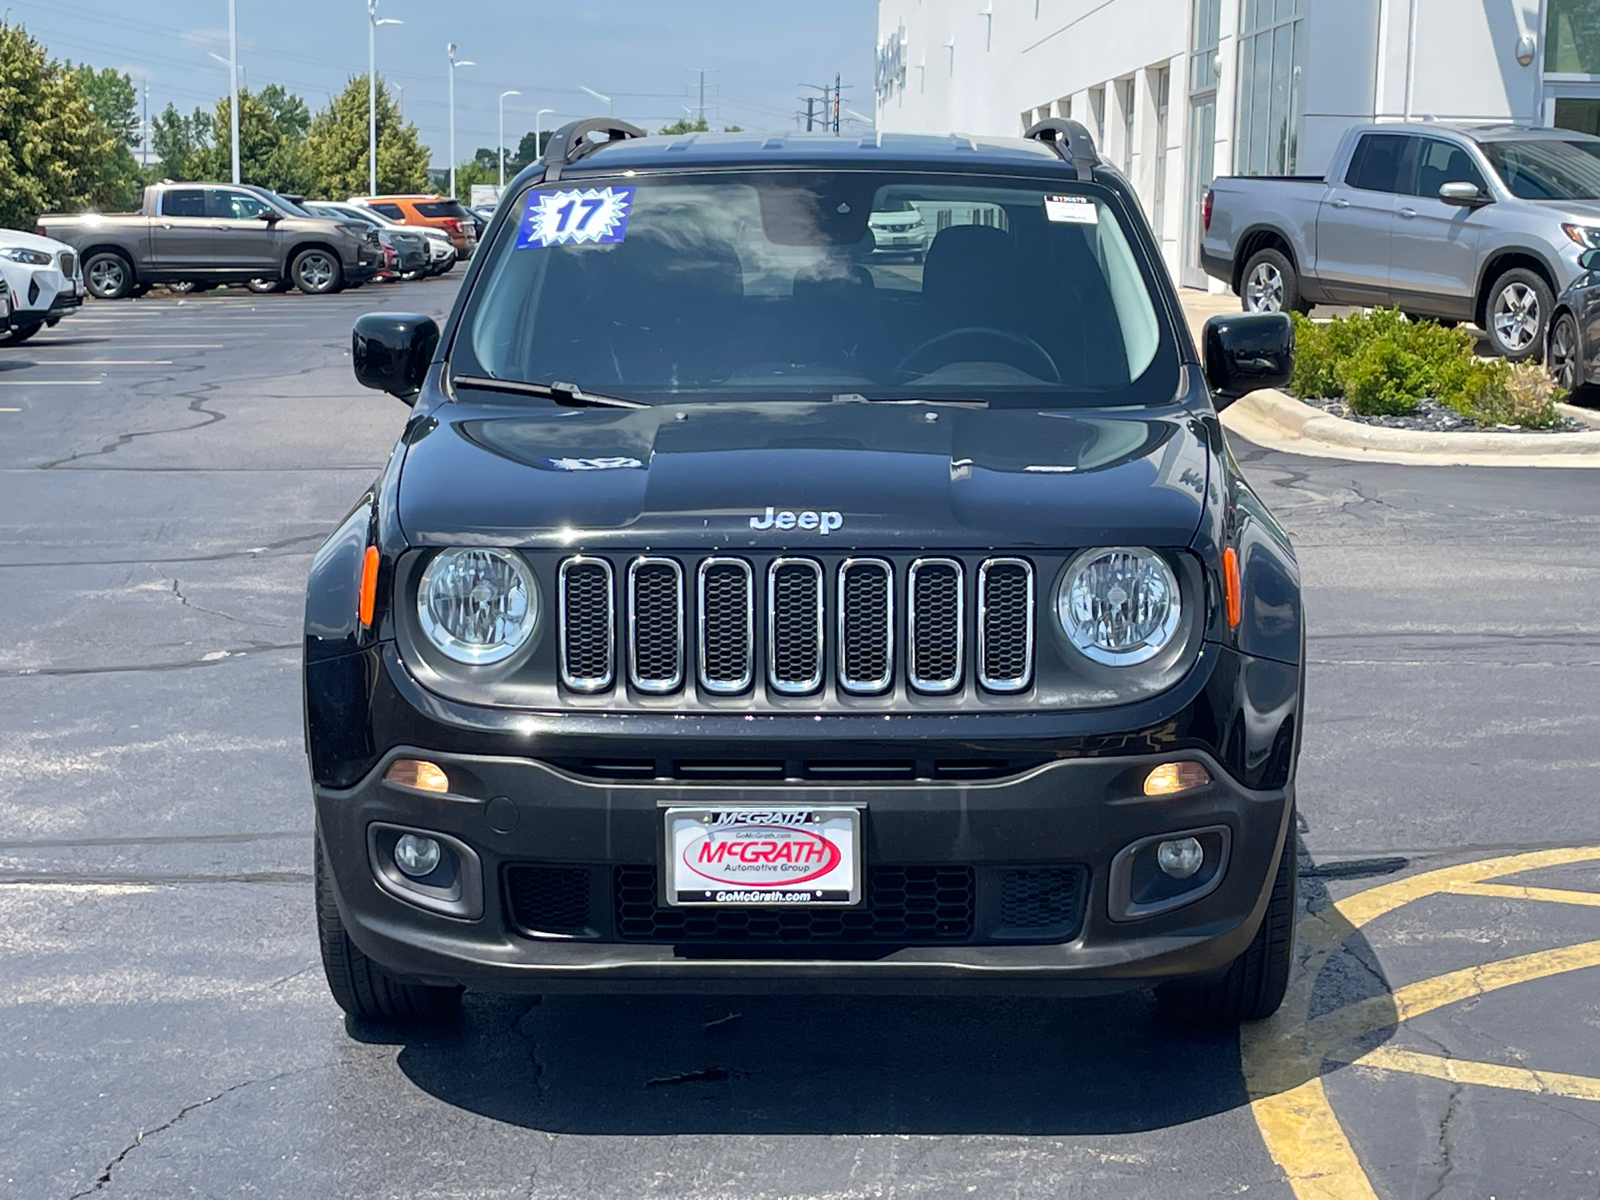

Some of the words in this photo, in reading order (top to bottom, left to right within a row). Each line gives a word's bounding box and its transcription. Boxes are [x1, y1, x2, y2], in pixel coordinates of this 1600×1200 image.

[555, 199, 606, 233] 17
[749, 506, 844, 535] Jeep
[724, 863, 778, 873] Automotive
[780, 863, 811, 873] Group
[715, 891, 811, 902] GoMcGrath.com
